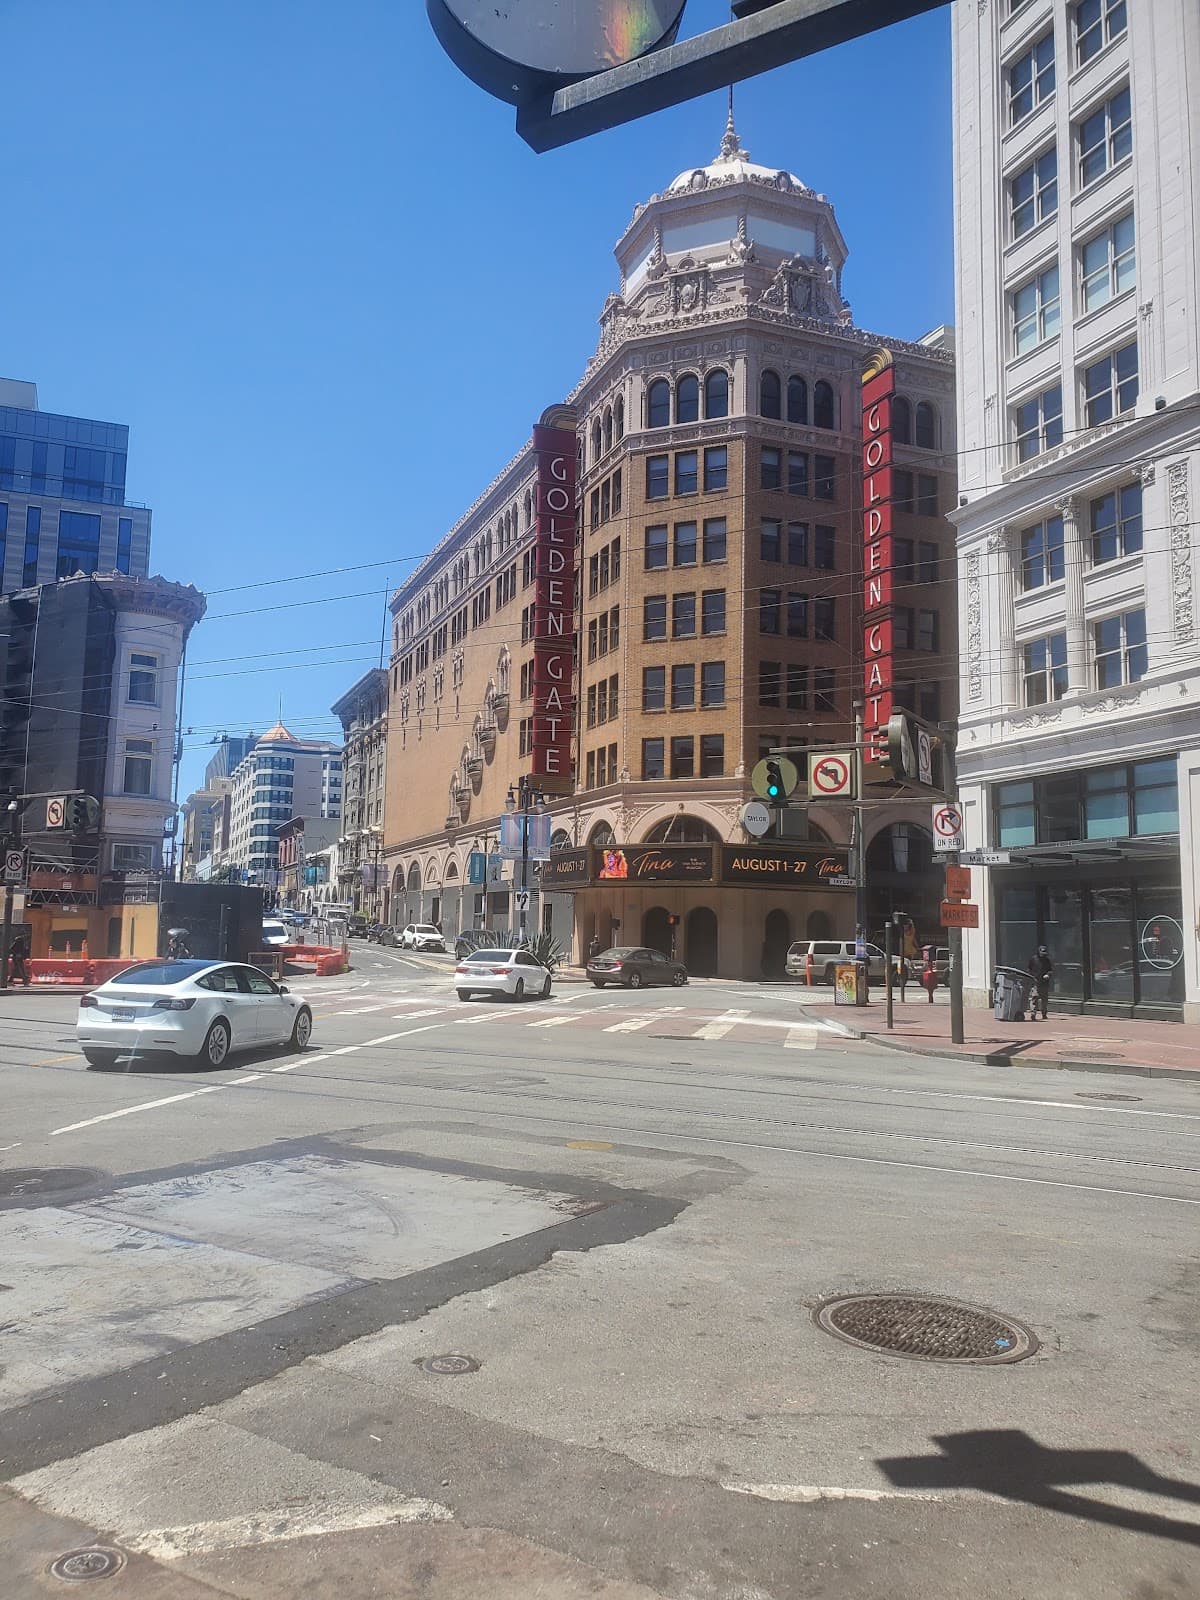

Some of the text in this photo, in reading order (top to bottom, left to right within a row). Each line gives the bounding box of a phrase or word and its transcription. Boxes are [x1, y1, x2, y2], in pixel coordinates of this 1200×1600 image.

[866, 405, 882, 761] GOLDEN GATE
[545, 457, 569, 774] GOLDEN GATE
[938, 838, 960, 847] ON RED
[556, 860, 575, 873] AUGUST
[632, 850, 675, 877] Tina
[732, 858, 781, 872] AUGUST
[814, 857, 846, 876] Tina
[969, 855, 1000, 863] Market
